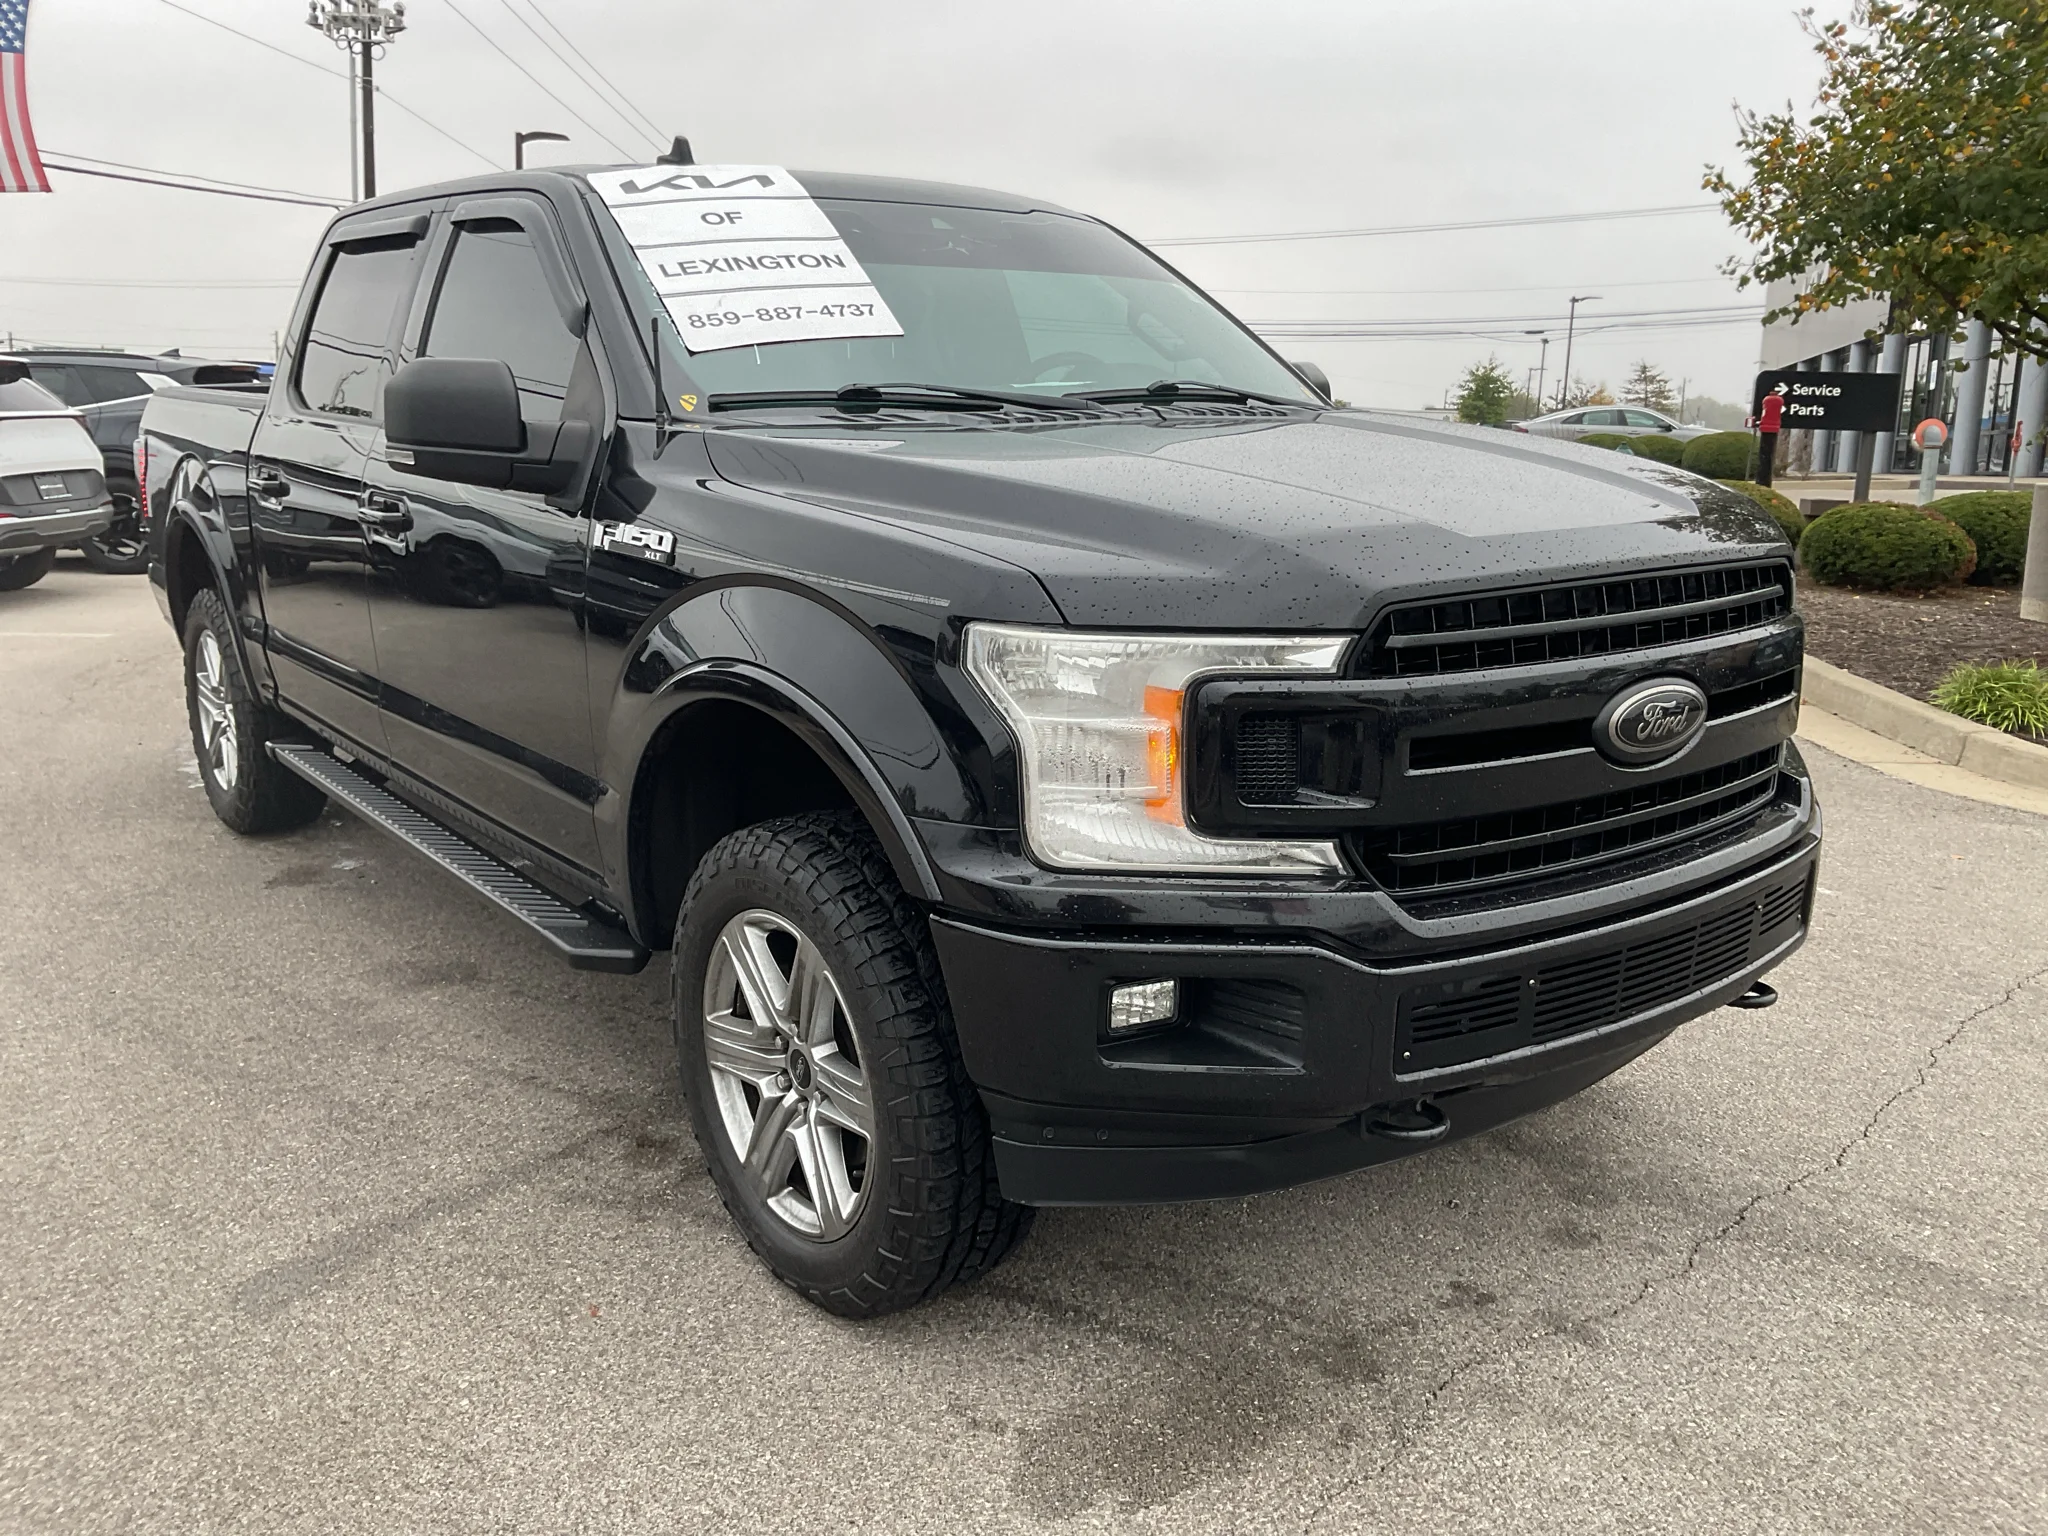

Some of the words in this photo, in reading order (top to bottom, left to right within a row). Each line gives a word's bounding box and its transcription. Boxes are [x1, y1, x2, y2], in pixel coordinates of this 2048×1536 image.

[700, 211, 743, 226] OF
[657, 253, 847, 279] LEXINGTON
[687, 303, 875, 330] 859-887-4737
[1792, 383, 1842, 397] Service
[1789, 403, 1825, 416] Parts
[644, 550, 661, 561] XLT
[1636, 700, 1689, 741] Ford
